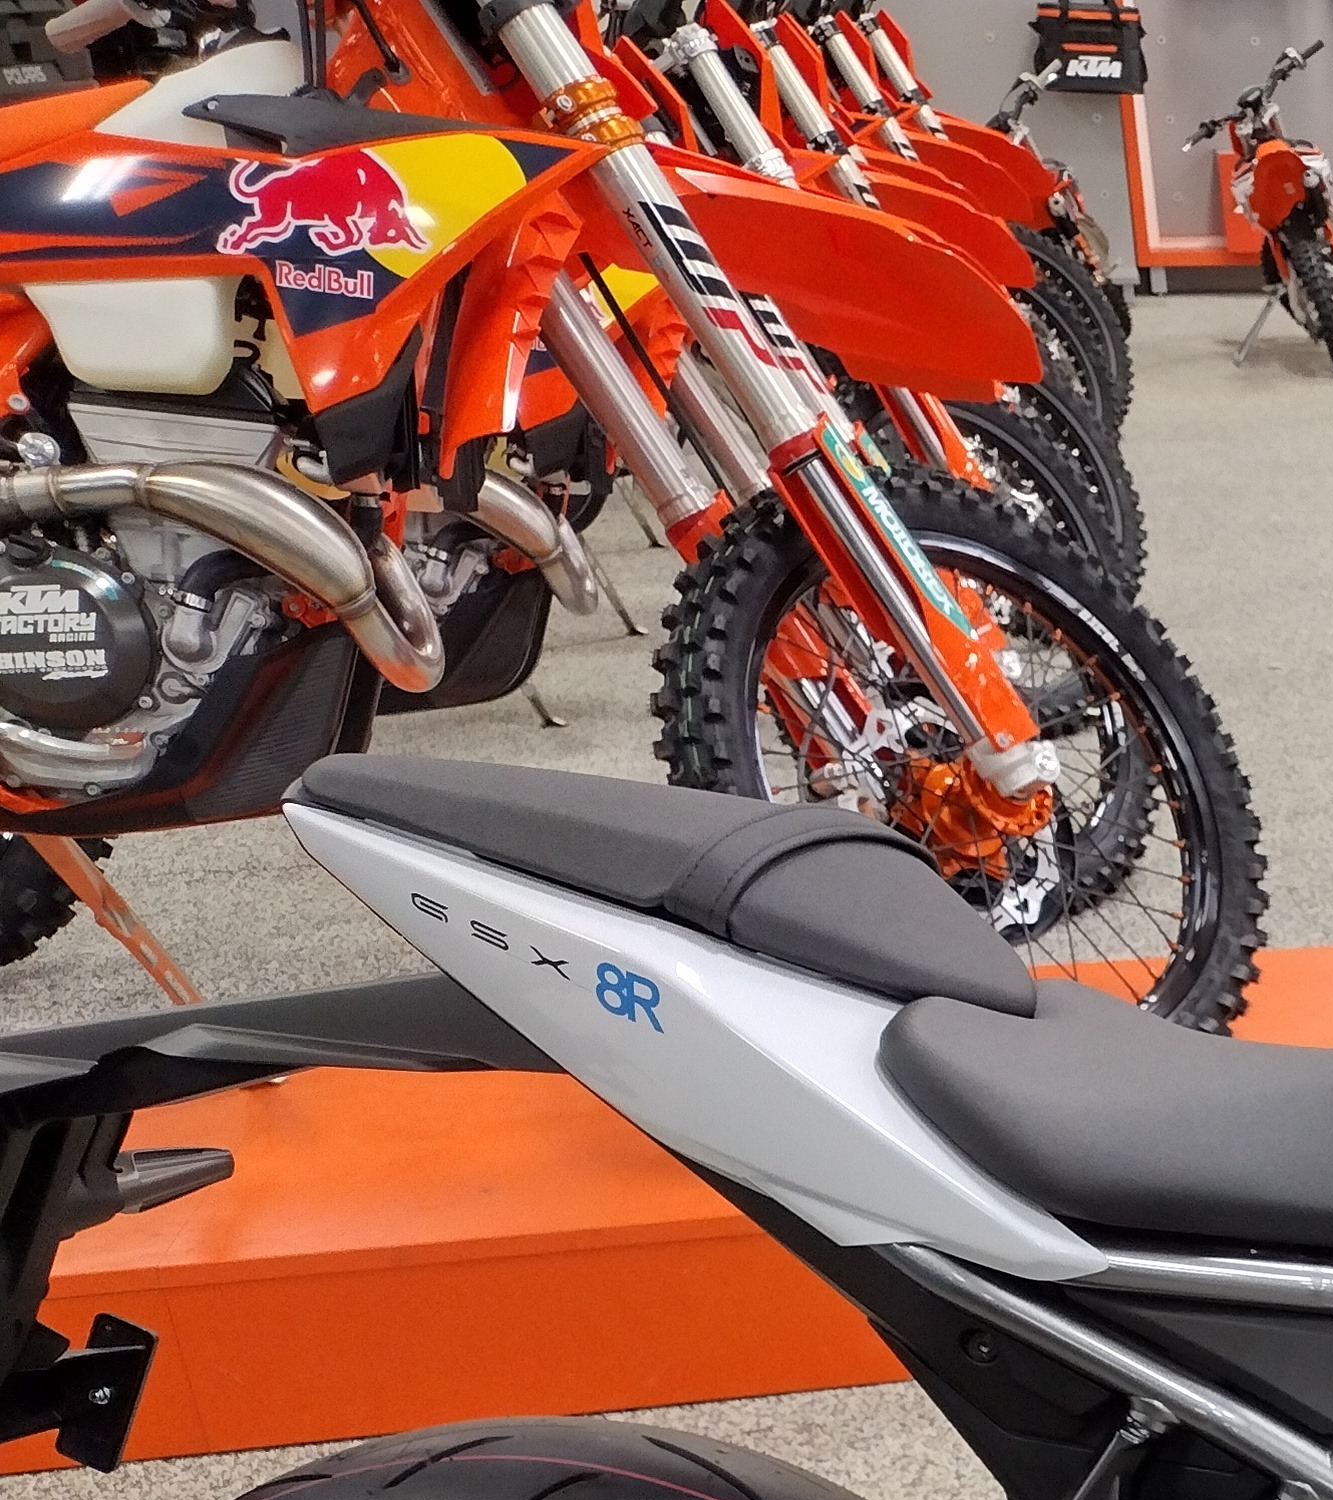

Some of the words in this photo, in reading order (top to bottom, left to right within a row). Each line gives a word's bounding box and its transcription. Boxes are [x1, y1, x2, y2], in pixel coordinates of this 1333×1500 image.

[1066, 55, 1123, 78] KTM
[622, 207, 652, 249] XACT
[862, 486, 951, 615] MOTOREX
[0, 612, 96, 634] ACTORY
[595, 962, 664, 1034] 8R
